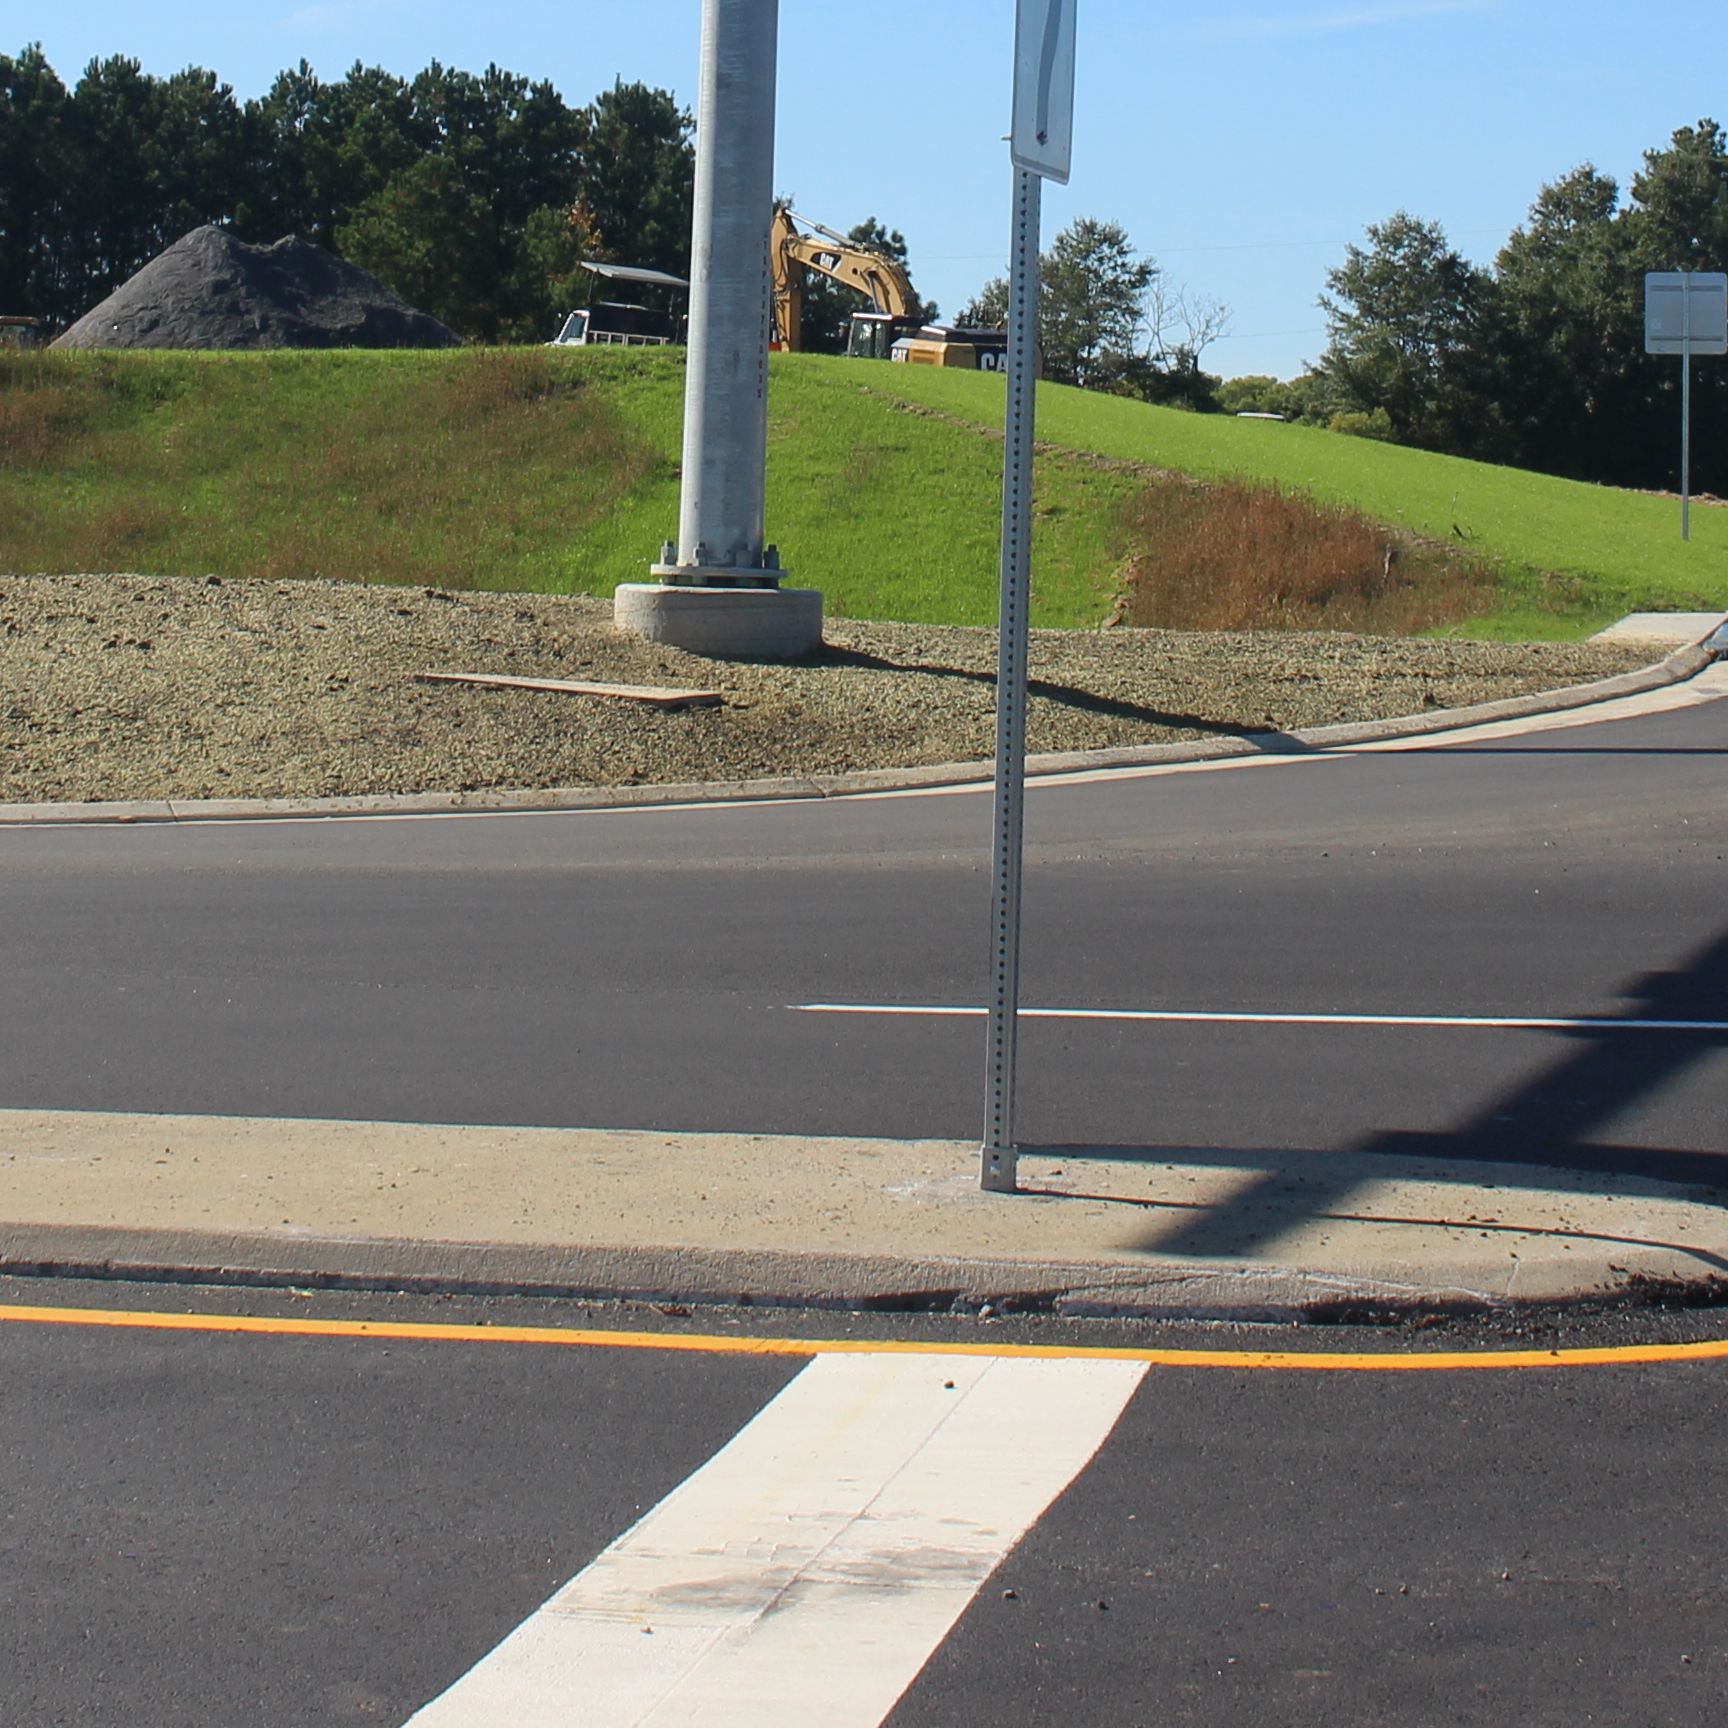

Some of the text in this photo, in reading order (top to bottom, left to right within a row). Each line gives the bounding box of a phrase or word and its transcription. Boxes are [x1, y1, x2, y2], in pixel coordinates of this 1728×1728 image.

[819, 252, 835, 270] CAT
[891, 348, 908, 363] CAT
[980, 352, 1008, 372] CA
